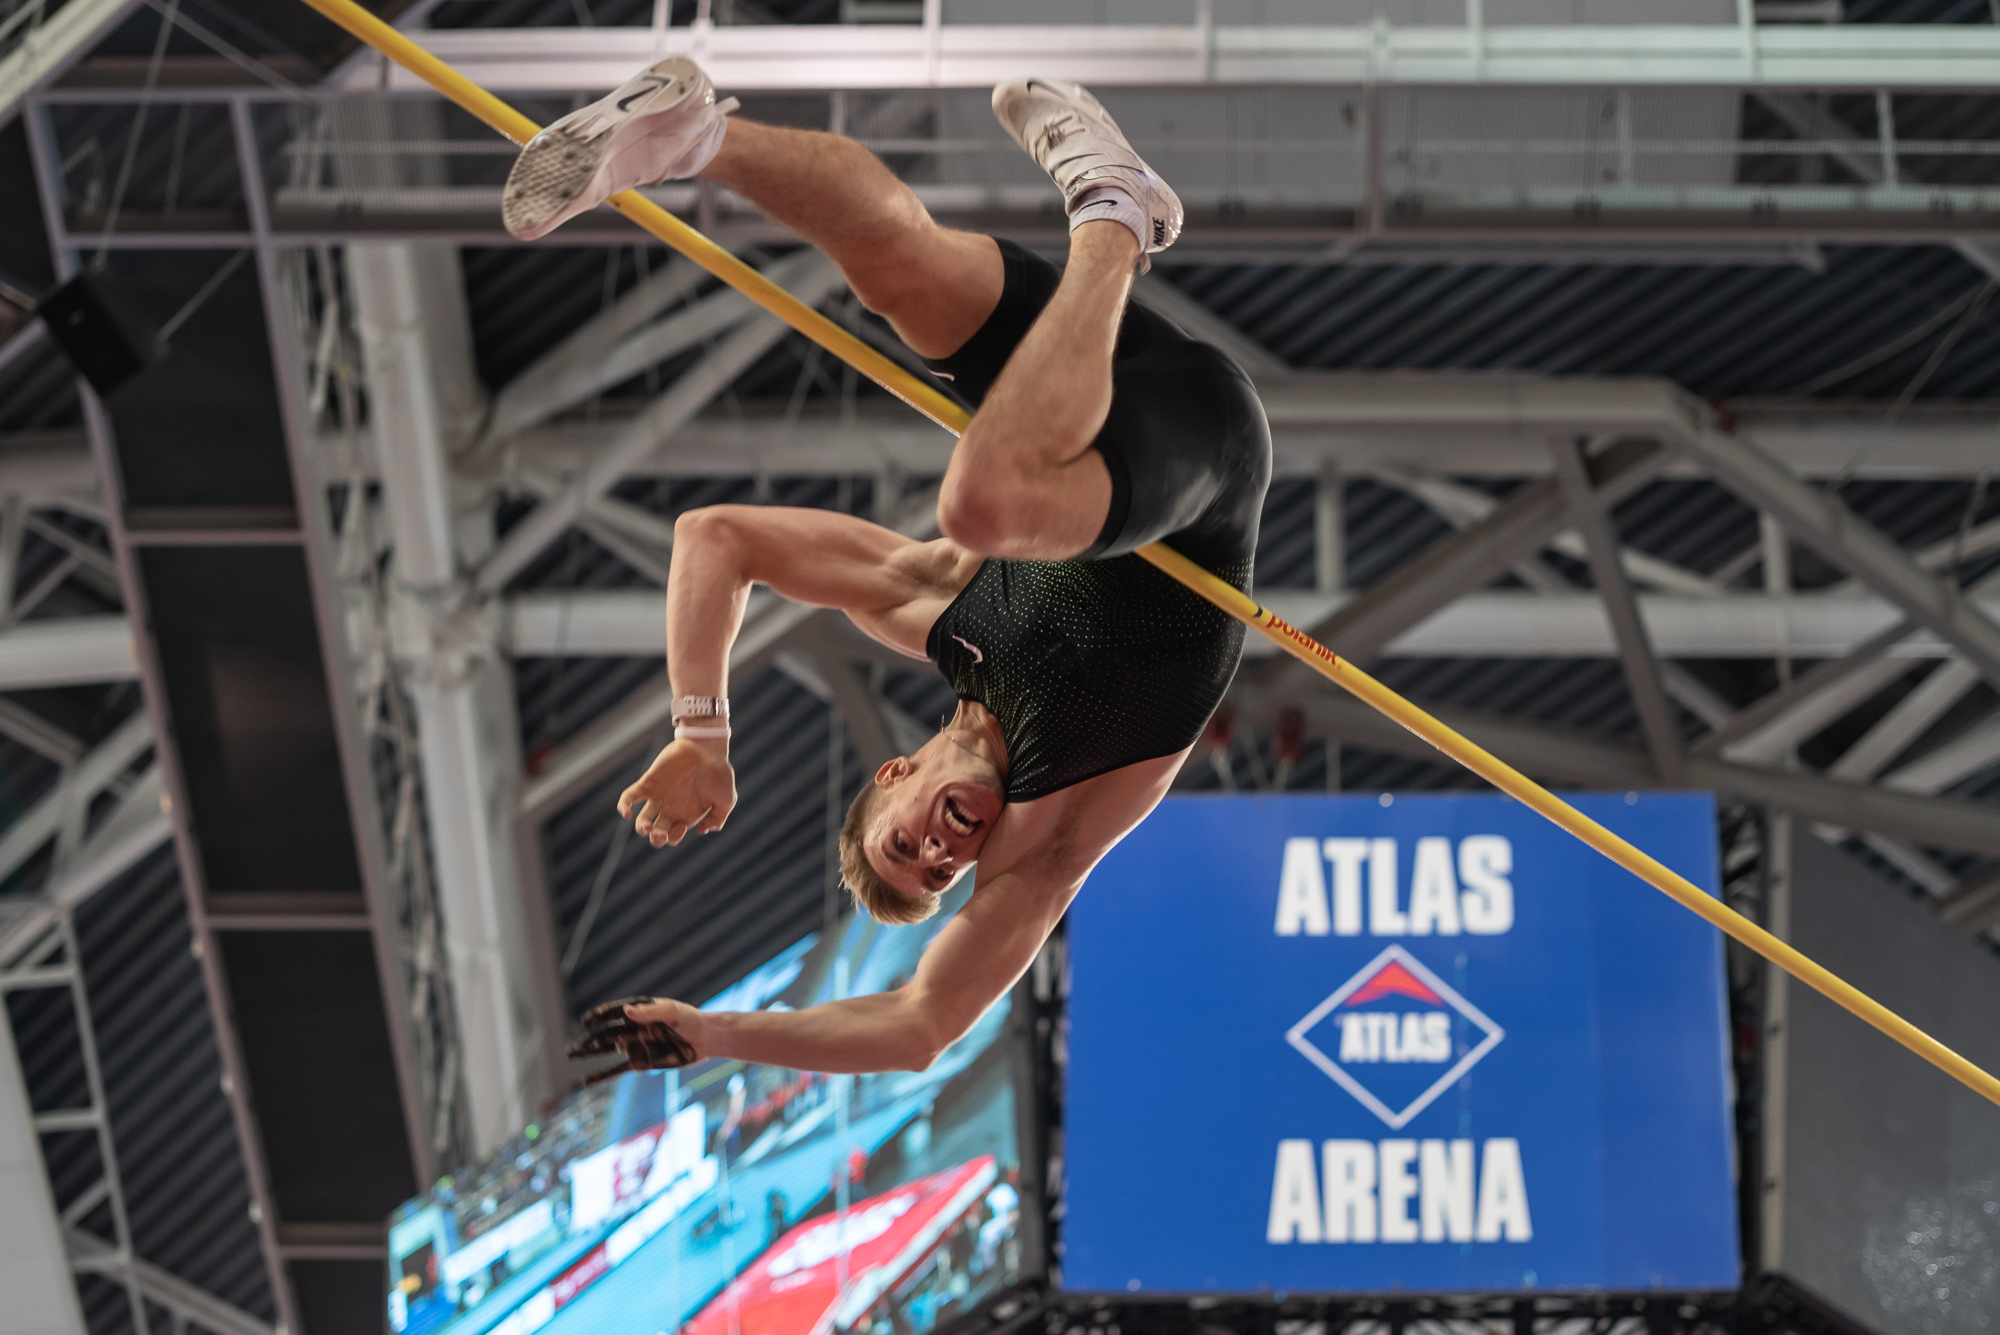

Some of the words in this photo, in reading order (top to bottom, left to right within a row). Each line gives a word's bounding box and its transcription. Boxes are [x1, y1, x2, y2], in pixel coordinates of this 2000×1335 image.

[1152, 216, 1165, 247] NIKE
[1275, 835, 1514, 936] ATLAS
[1340, 1013, 1451, 1063] ATLAS
[1267, 1138, 1533, 1243] ARENA
